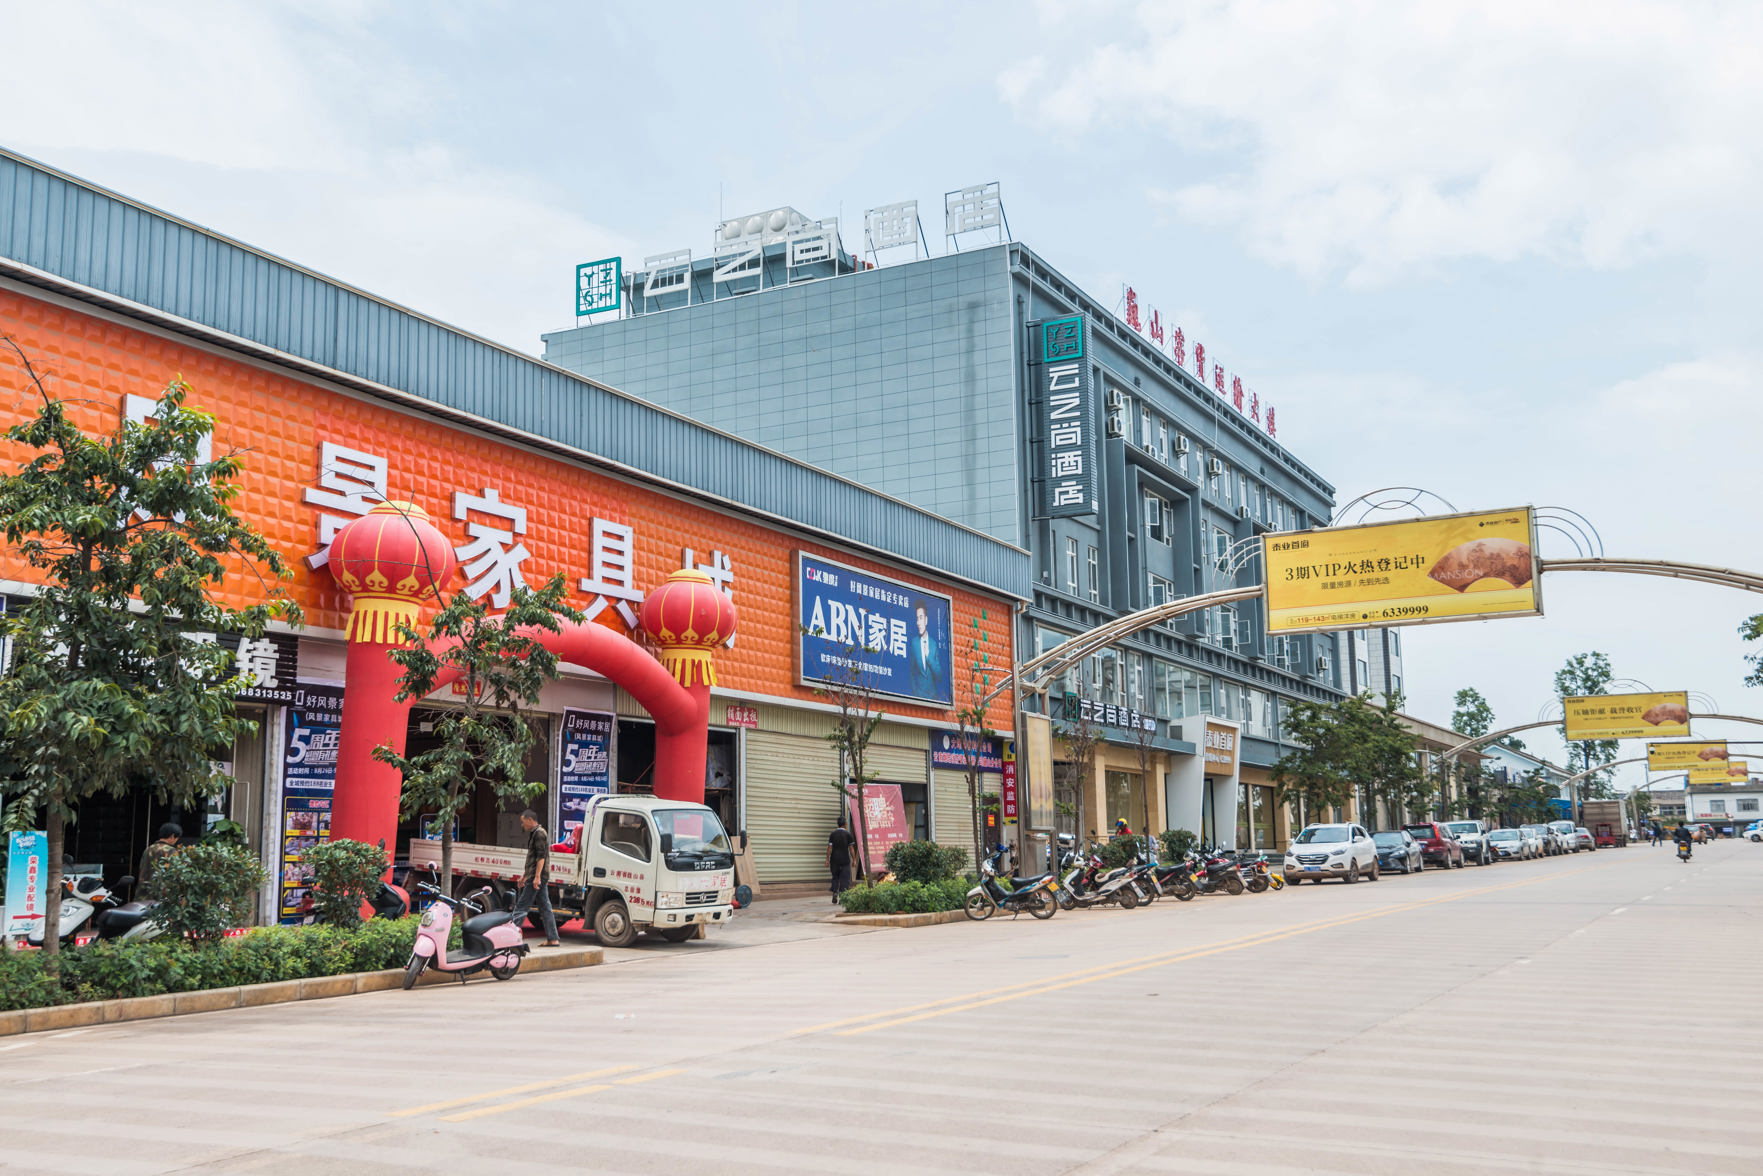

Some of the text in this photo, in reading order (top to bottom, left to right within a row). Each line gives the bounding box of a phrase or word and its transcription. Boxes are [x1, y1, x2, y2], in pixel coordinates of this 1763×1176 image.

[1285, 554, 1426, 582] 3期VIP火热登记中
[1382, 604, 1430, 619] 6339999
